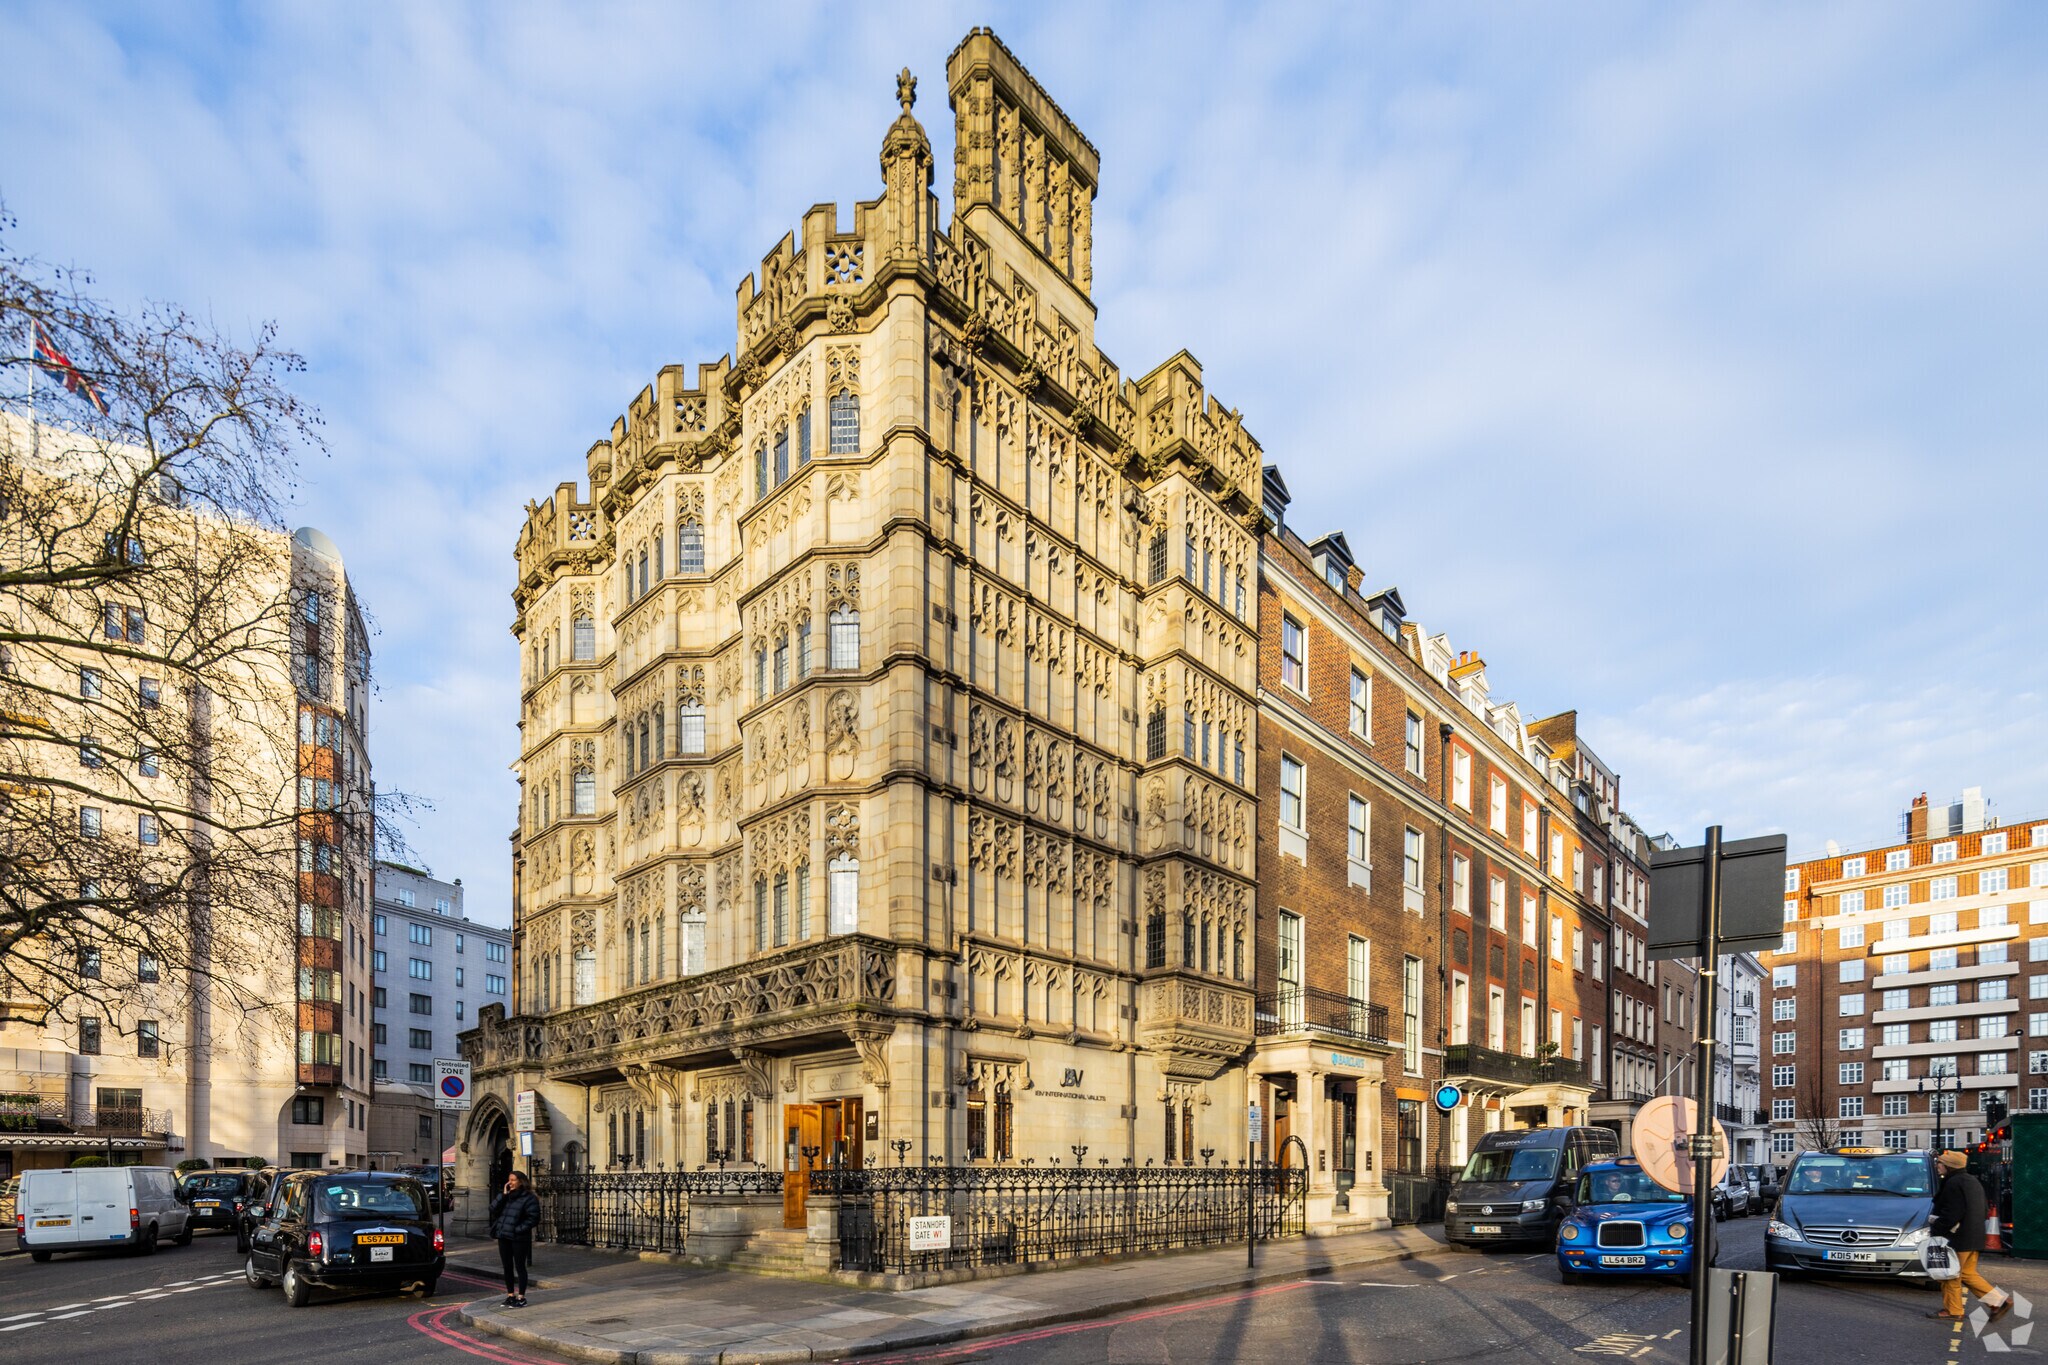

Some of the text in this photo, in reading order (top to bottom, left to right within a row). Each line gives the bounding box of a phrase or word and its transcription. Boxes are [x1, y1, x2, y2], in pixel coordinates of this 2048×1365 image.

[436, 1060, 469, 1069] Controlled
[441, 1067, 464, 1075] ZONE
[1045, 1091, 1086, 1100] INTERNATIONAL
[1087, 1094, 1107, 1102] VAULTS
[915, 1220, 946, 1230] STANHOPE
[915, 1230, 942, 1240] GATE W1
[1603, 1256, 1644, 1264] LL54 BRZ
